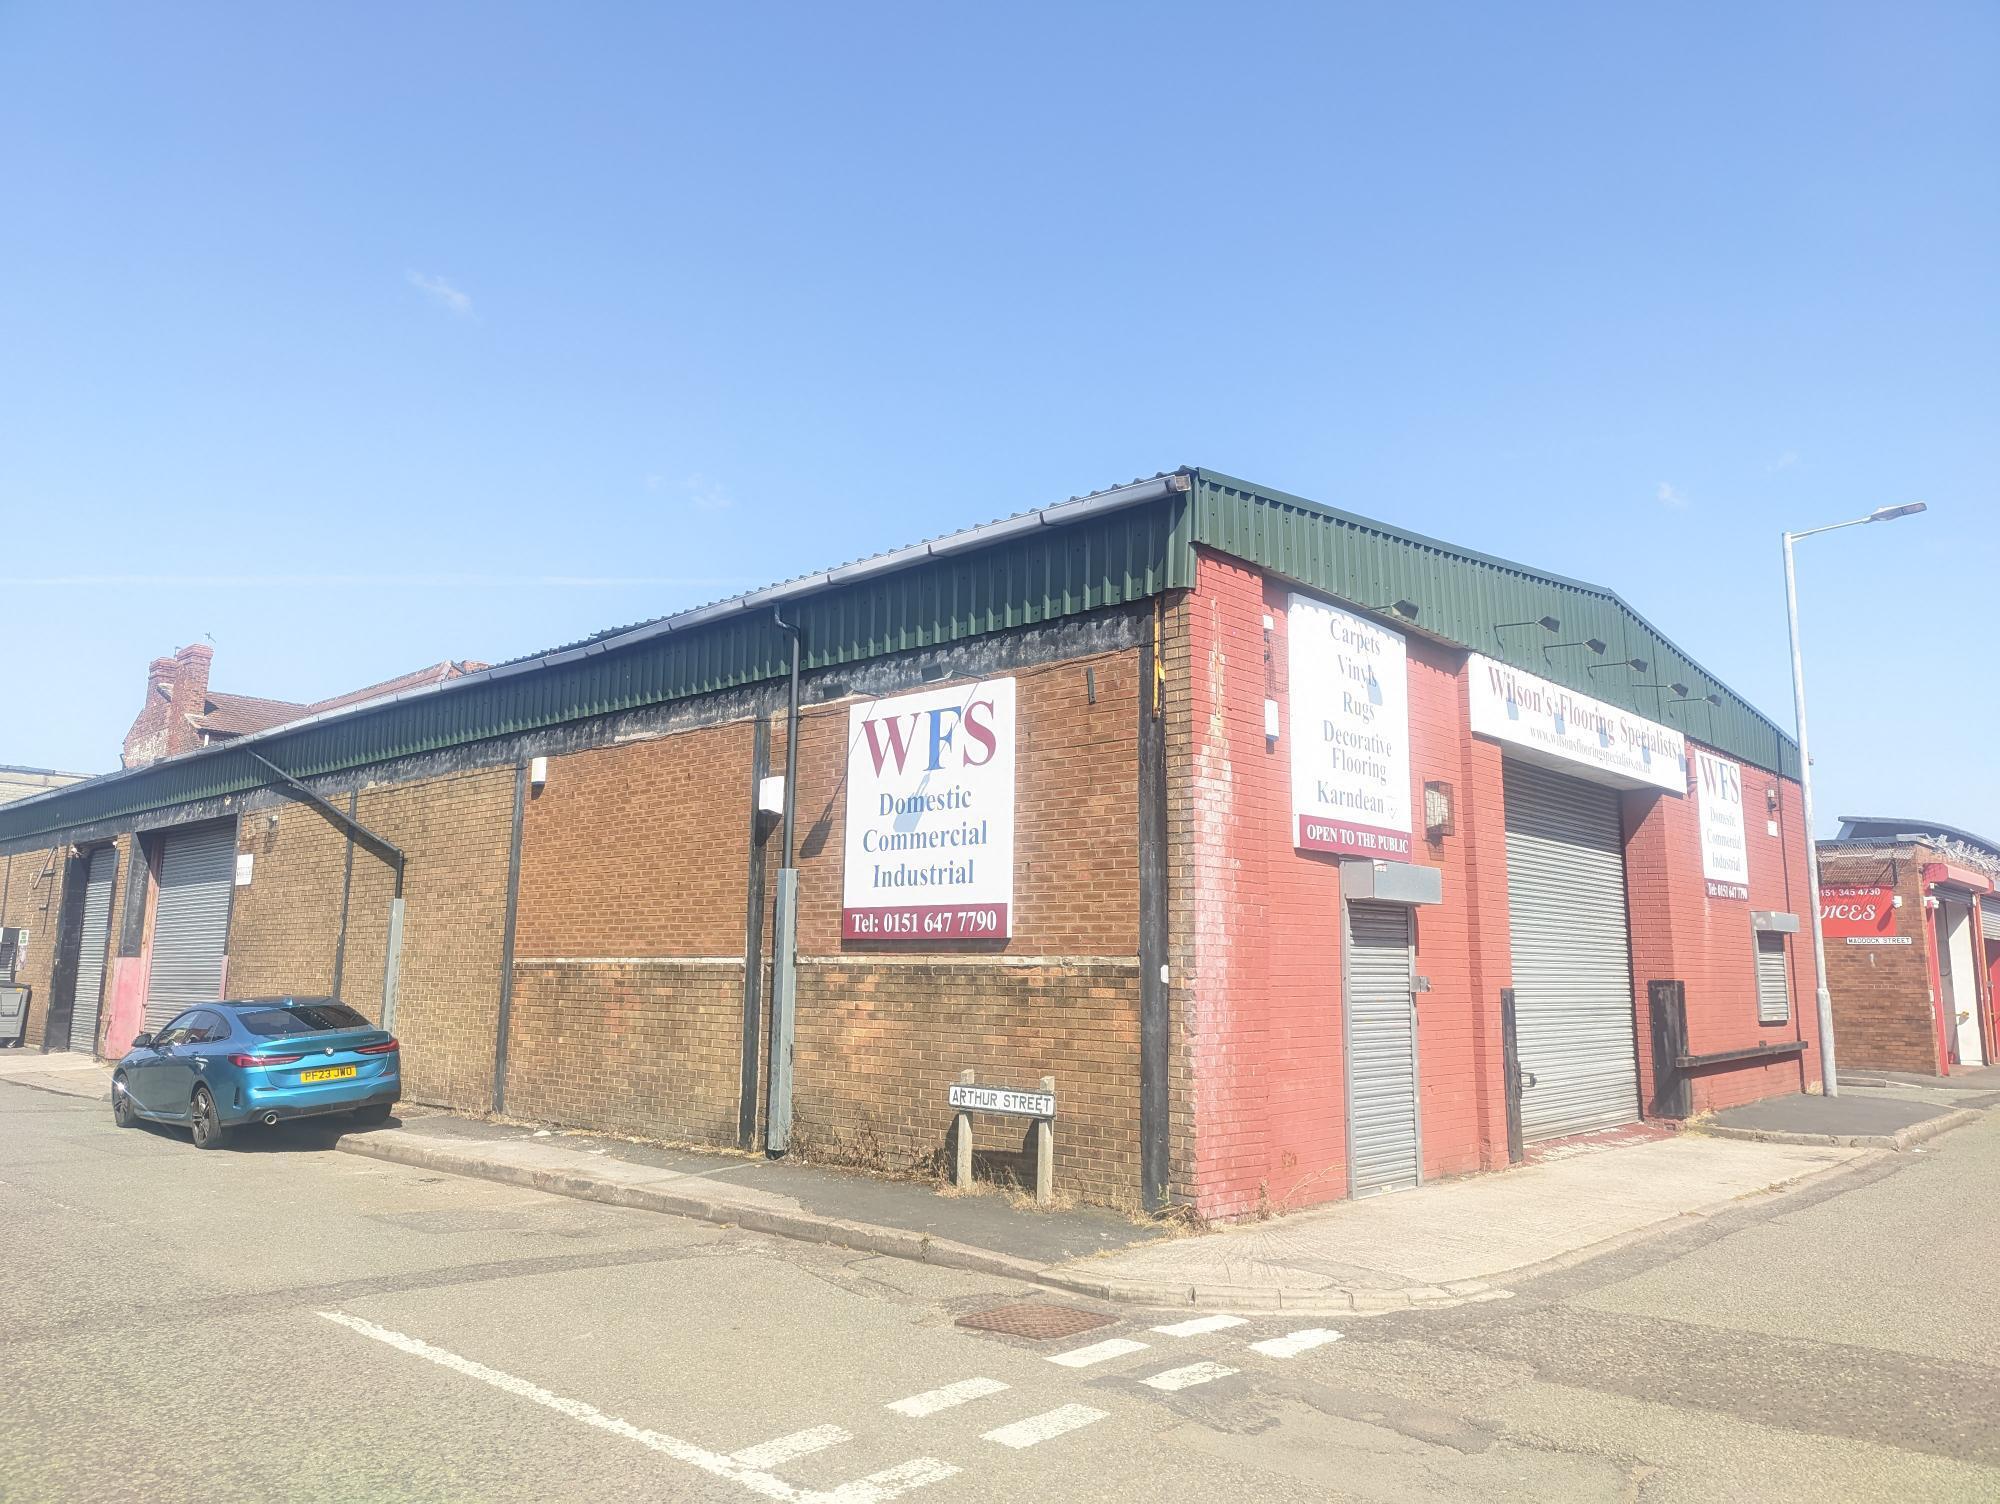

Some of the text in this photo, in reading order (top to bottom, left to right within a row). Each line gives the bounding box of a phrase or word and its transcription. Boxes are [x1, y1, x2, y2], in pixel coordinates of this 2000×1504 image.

[1330, 618, 1381, 655] Carpets
[1337, 654, 1377, 688] Vinyls
[1343, 691, 1375, 724] Rugs
[1488, 666, 1677, 760] Wilson's Flooring Specialists
[861, 699, 997, 779] WFS
[1323, 719, 1392, 757] Decorative
[1332, 747, 1387, 785] Flooring
[1700, 755, 1739, 805] WFS
[879, 785, 972, 817] Domestic
[1317, 780, 1384, 814] Karndean
[862, 820, 988, 853] Commercial
[1306, 824, 1409, 854] OPEN TO THE PUBLIC
[873, 859, 975, 889] Industrial
[1712, 851, 1741, 872] Industrial
[1839, 888, 1856, 897] 345
[1857, 887, 1881, 896] 4730
[852, 910, 997, 933] Tel: 0151 647 7790
[305, 1069, 331, 1081] PF23
[952, 1088, 1051, 1112] ARTHUR STREET
